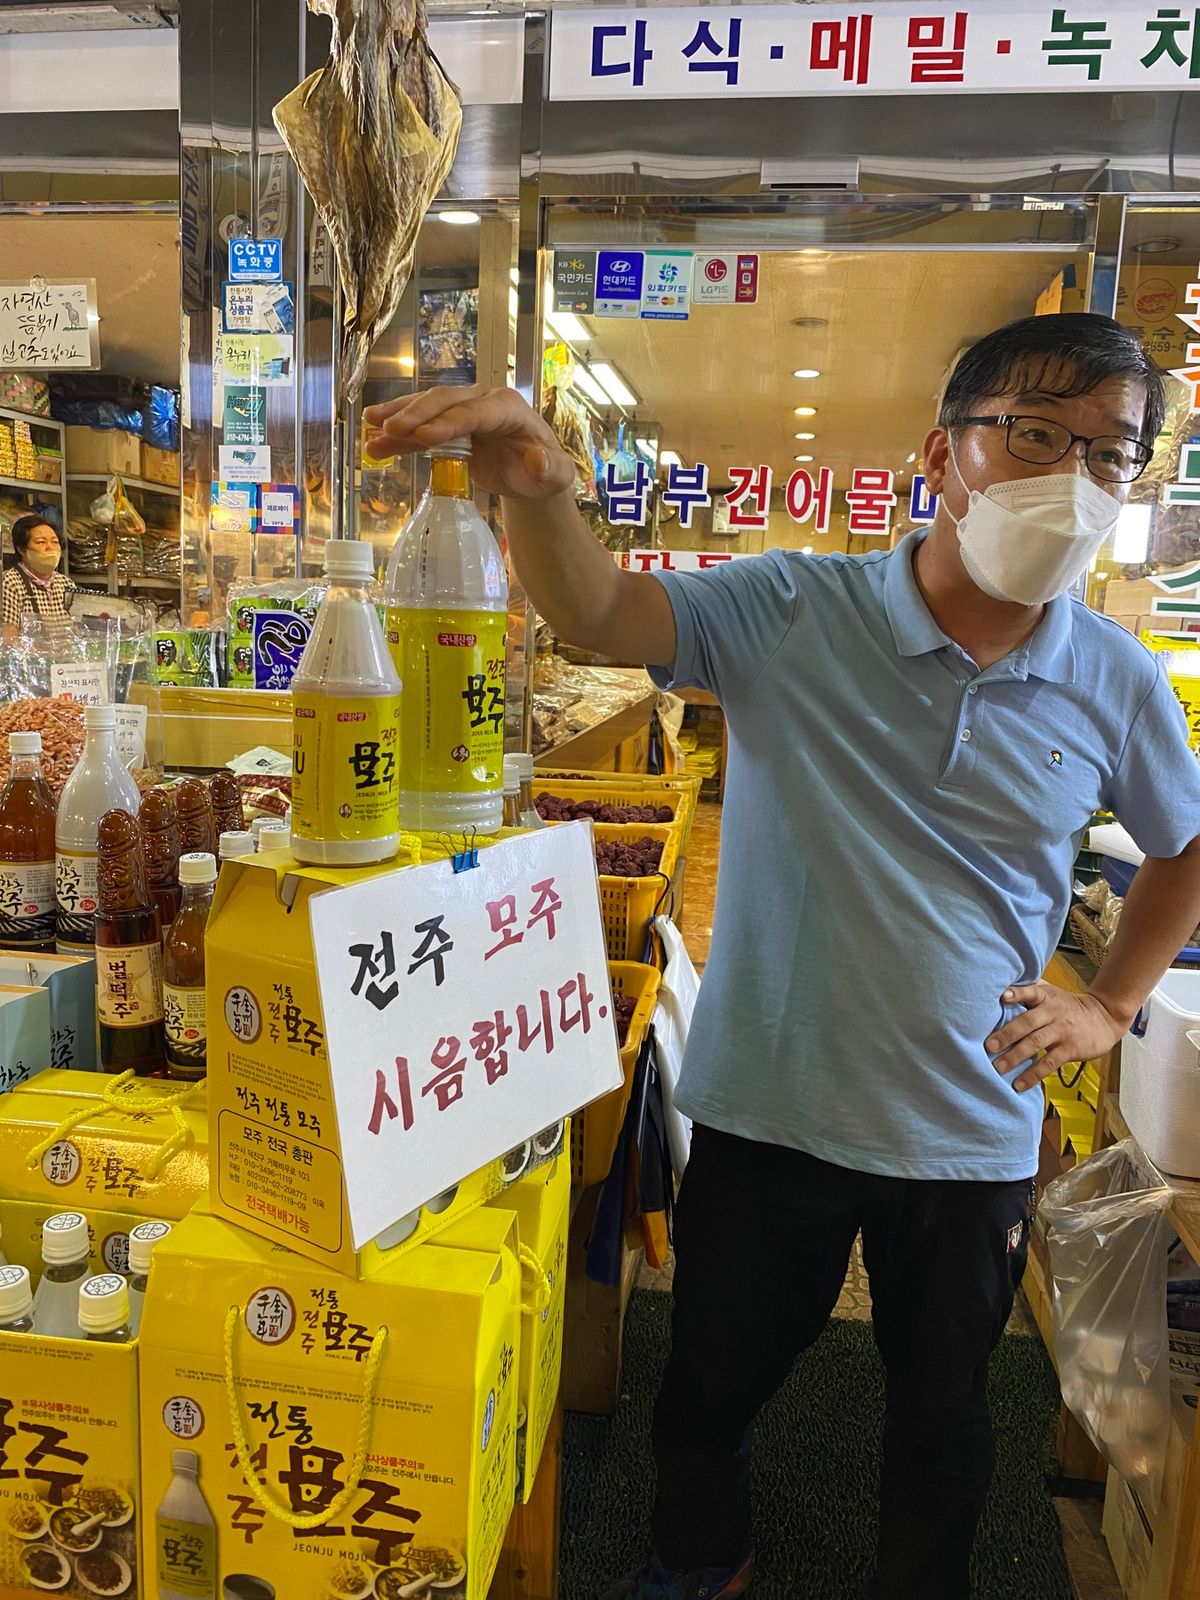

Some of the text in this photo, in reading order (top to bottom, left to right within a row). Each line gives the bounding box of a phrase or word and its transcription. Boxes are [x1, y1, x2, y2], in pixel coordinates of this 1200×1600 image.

[233, 243, 277, 256] CCTV
[558, 273, 593, 284] 국민카드
[603, 275, 636, 286] 현대카드
[647, 284, 687, 294] 외환카드
[701, 285, 729, 294] LG카드
[2, 291, 53, 311] 자연산
[229, 295, 254, 306] 온누리
[230, 305, 254, 316] 상품권
[267, 505, 289, 513] 제로페이
[440, 635, 474, 645] 국내산쌀
[462, 674, 505, 734] 모주
[348, 741, 396, 793] 모주
[348, 876, 562, 1011] 전주 모주
[108, 960, 132, 1019] 벌떡주
[272, 983, 294, 1004] 전통
[283, 1004, 325, 1057] 모주
[367, 972, 608, 1136] 시음합니다.
[236, 1086, 321, 1138] 전주 전통 모주
[243, 1126, 313, 1167] 모주 전국 총판
[229, 1141, 246, 1155] 전주시
[247, 1150, 265, 1163] 덕진구
[298, 1170, 310, 1182] 103
[244, 1158, 293, 1185] 010-3496-1119
[103, 1156, 145, 1198] 모주
[246, 1194, 310, 1234] 전국택배가능
[310, 1288, 339, 1310] 전통
[301, 1311, 320, 1355] 전주
[322, 1310, 375, 1363] 모주
[22, 1408, 55, 1421] 전주모주는
[58, 1413, 86, 1424] 전주에서
[246, 1401, 313, 1445] 전통
[392, 1468, 421, 1480] 전주에서
[424, 1473, 456, 1486] 만듭니다.
[278, 1445, 423, 1567] 모주
[292, 1543, 368, 1562] JEONJU MOJU
